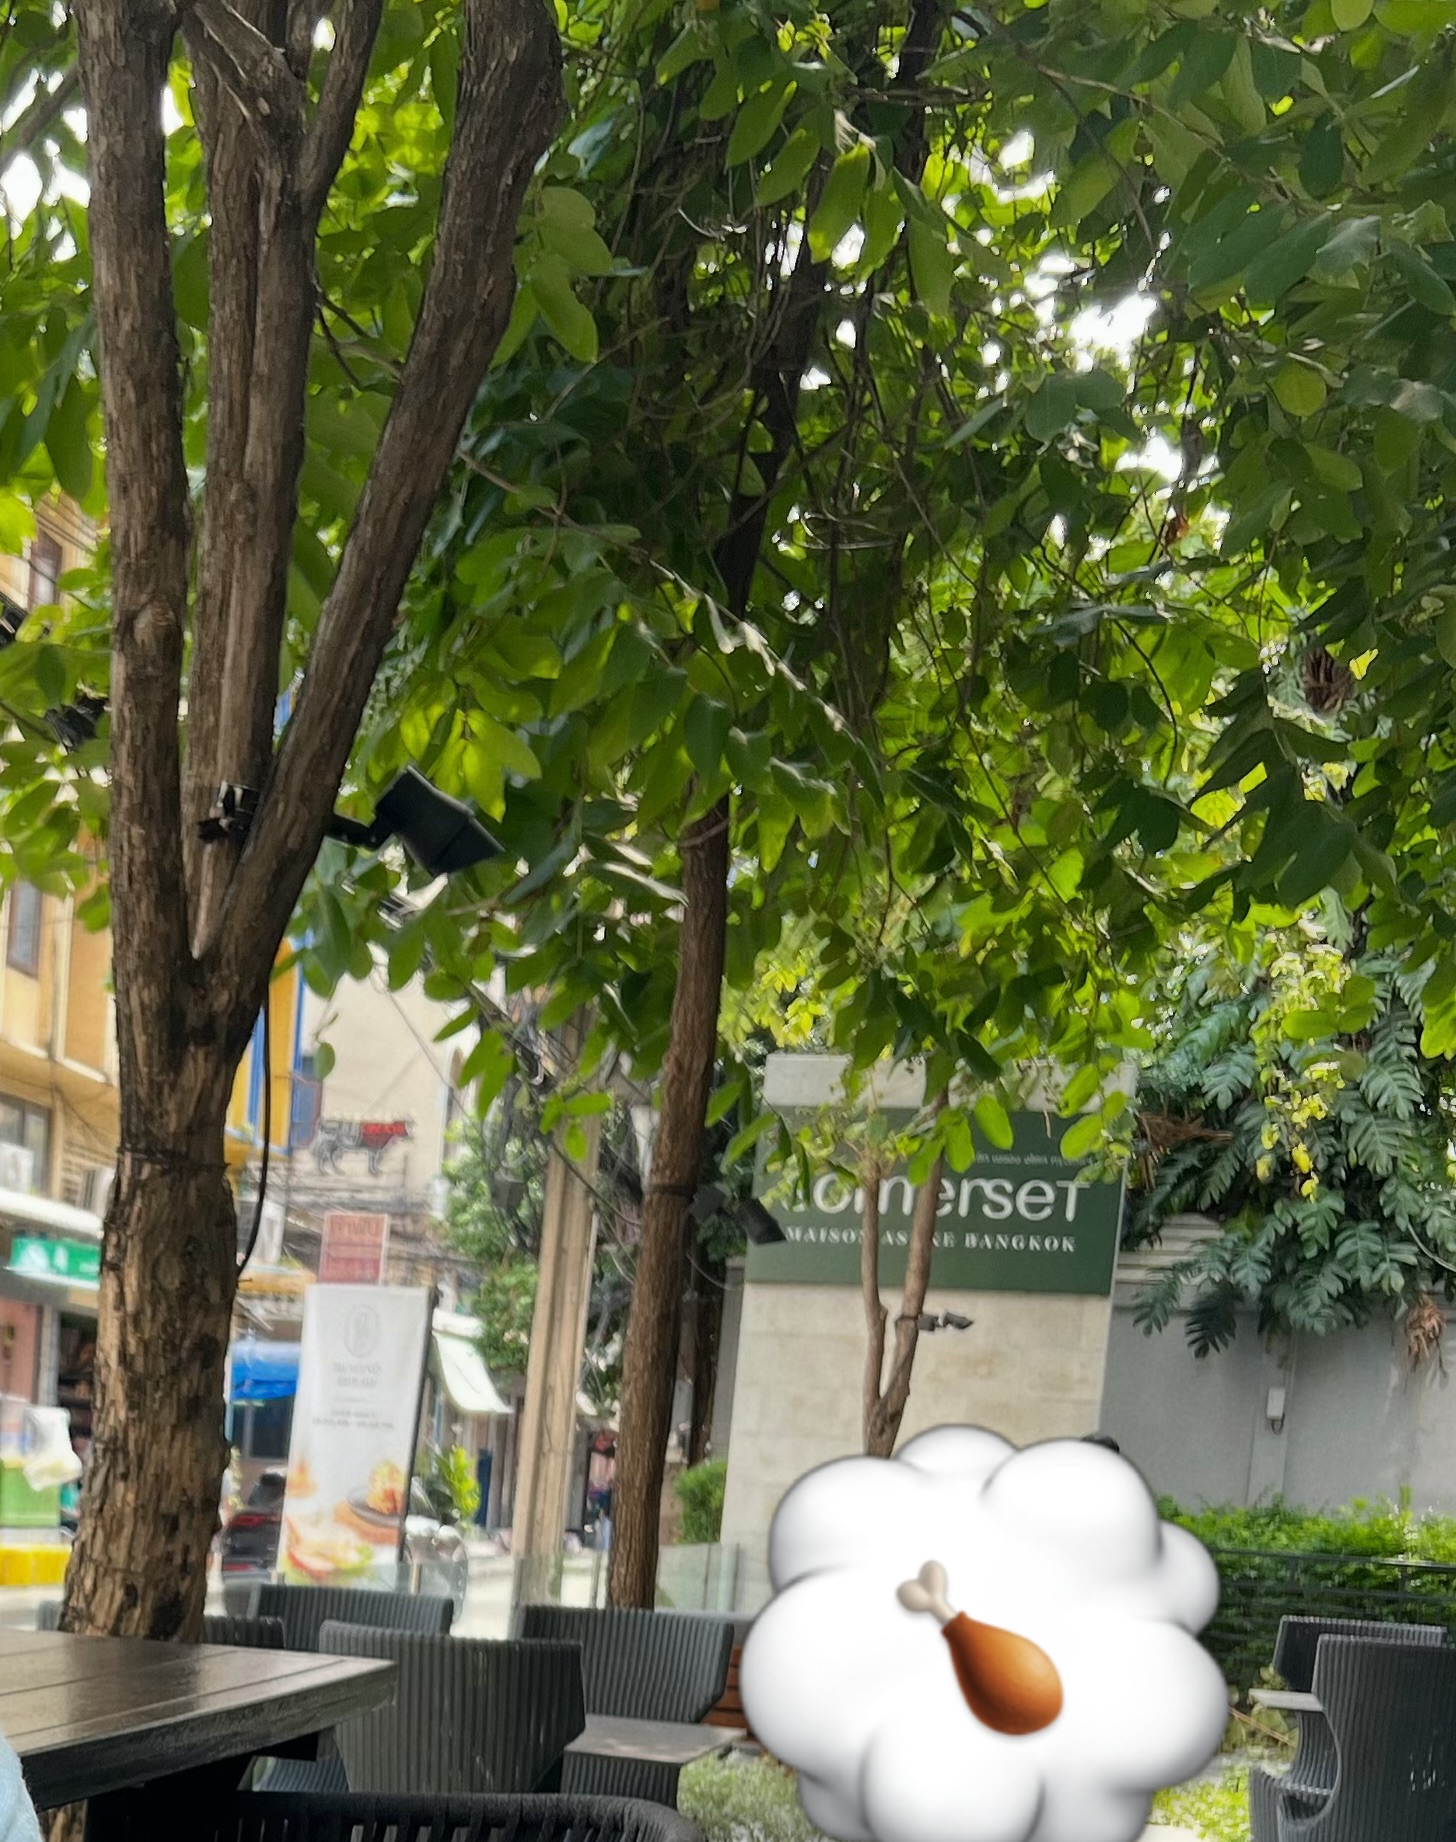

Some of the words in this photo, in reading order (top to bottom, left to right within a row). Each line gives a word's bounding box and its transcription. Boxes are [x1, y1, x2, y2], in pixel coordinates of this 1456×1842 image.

[786, 1226, 864, 1244] MAISO
[881, 1230, 955, 1247] ASE
[965, 1231, 1076, 1252] BANGKOK
